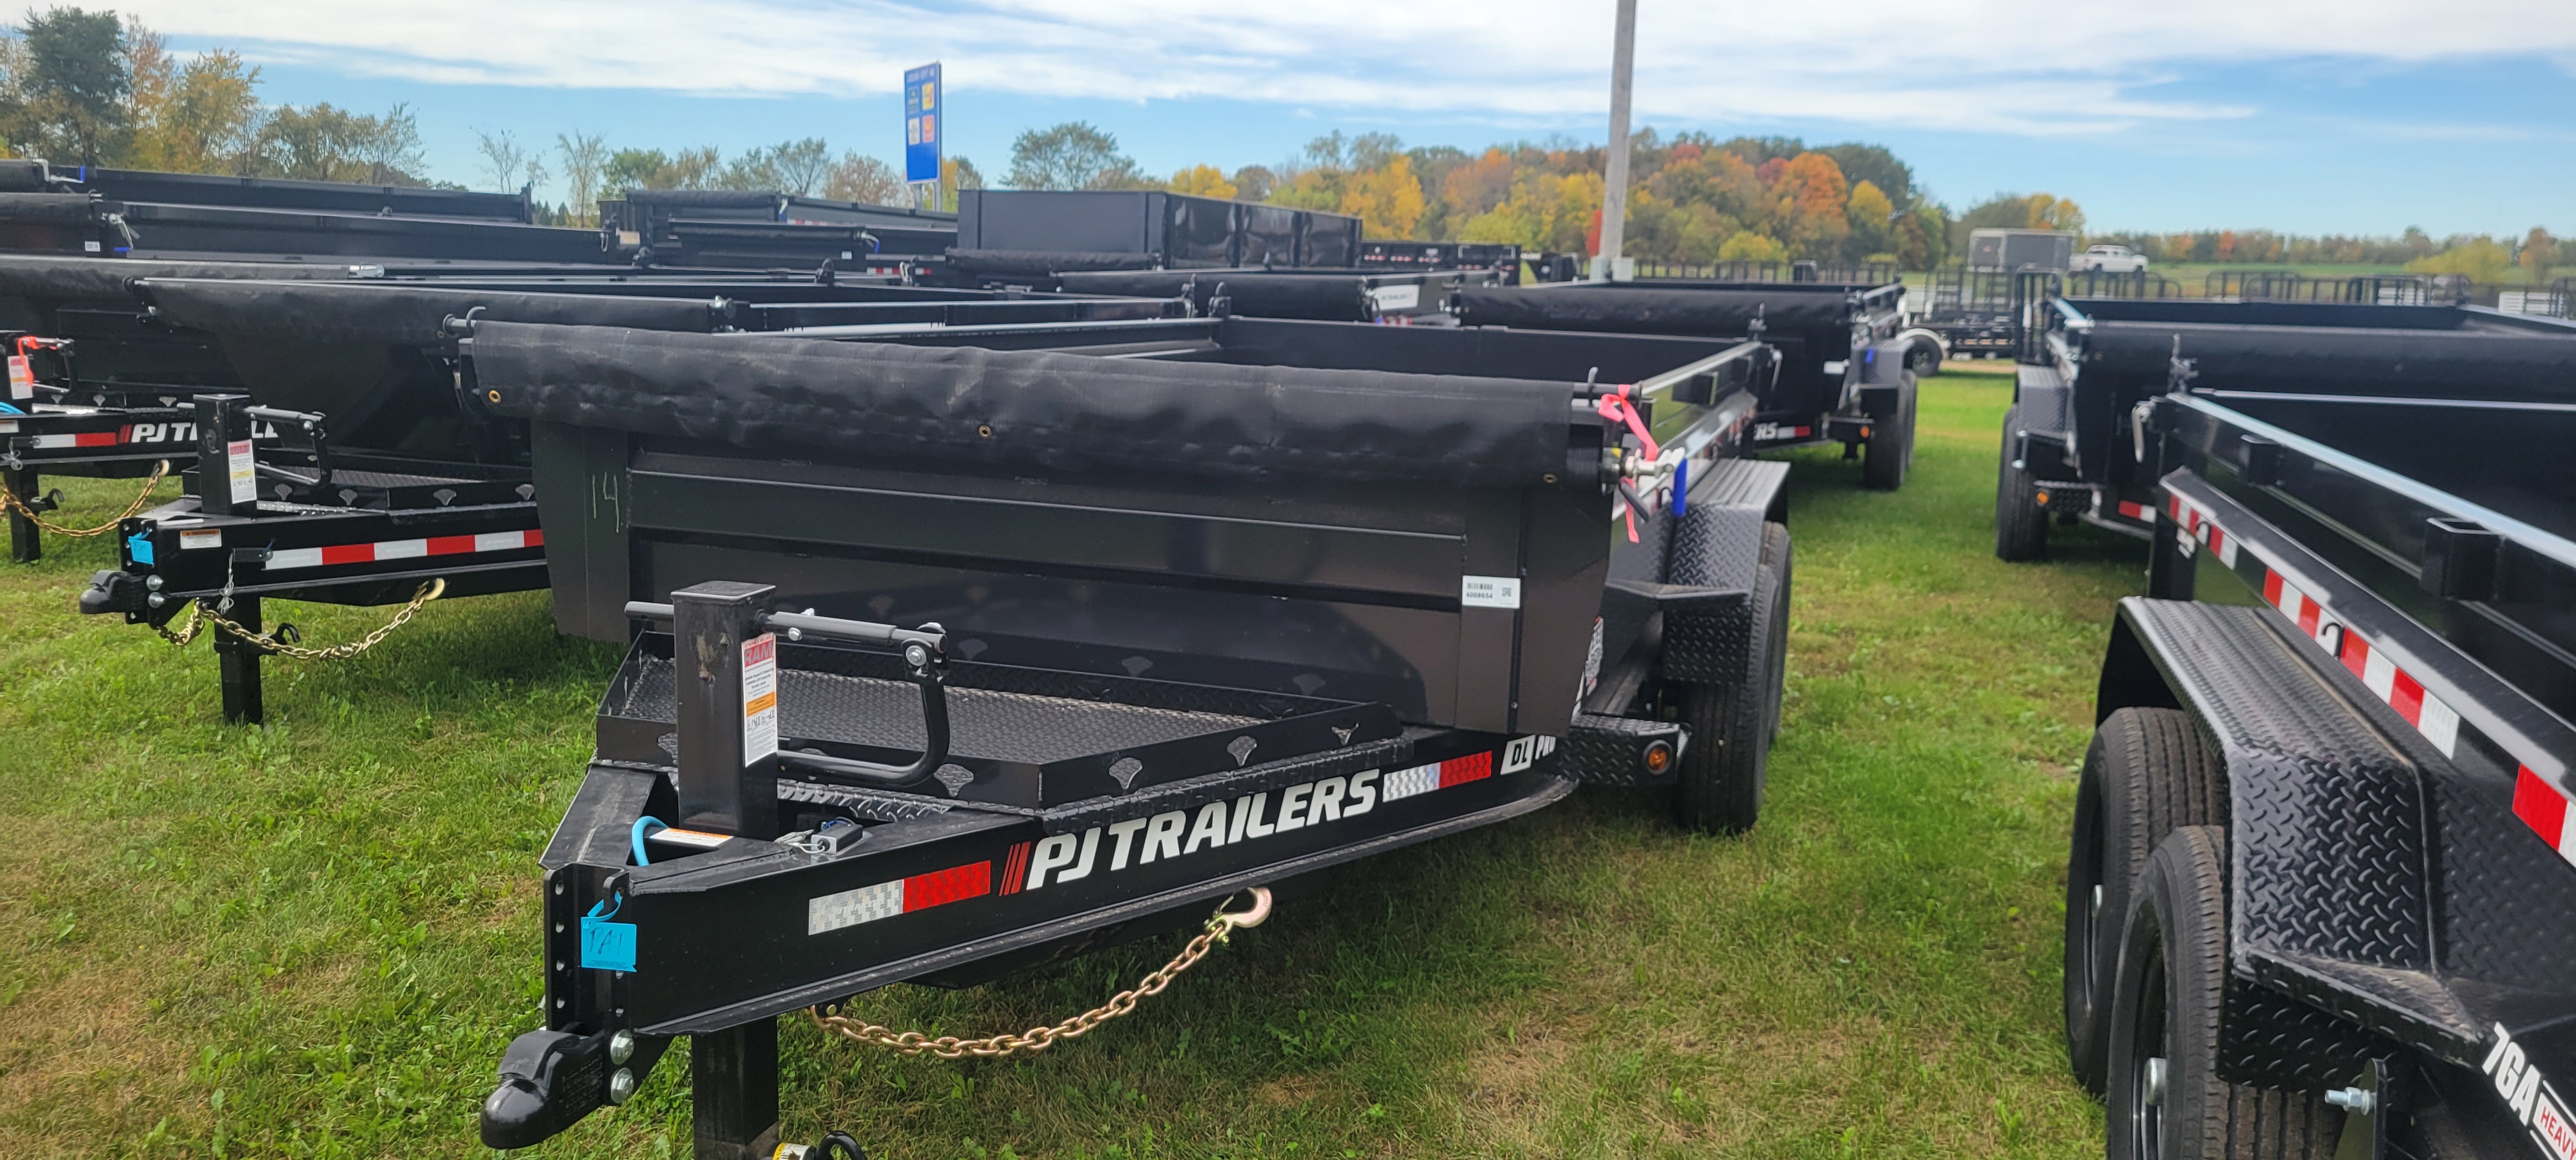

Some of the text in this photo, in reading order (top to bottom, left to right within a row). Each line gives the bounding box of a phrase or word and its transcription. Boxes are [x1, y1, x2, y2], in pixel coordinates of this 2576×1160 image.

[132, 424, 167, 443] PJ
[592, 472, 619, 533] 14
[744, 641, 773, 667] RAM
[1510, 740, 1528, 767] DL
[1108, 769, 1379, 871] TRAILERS
[2482, 1021, 2541, 1127] 7GA
[2540, 1106, 2576, 1160] HEAVY
